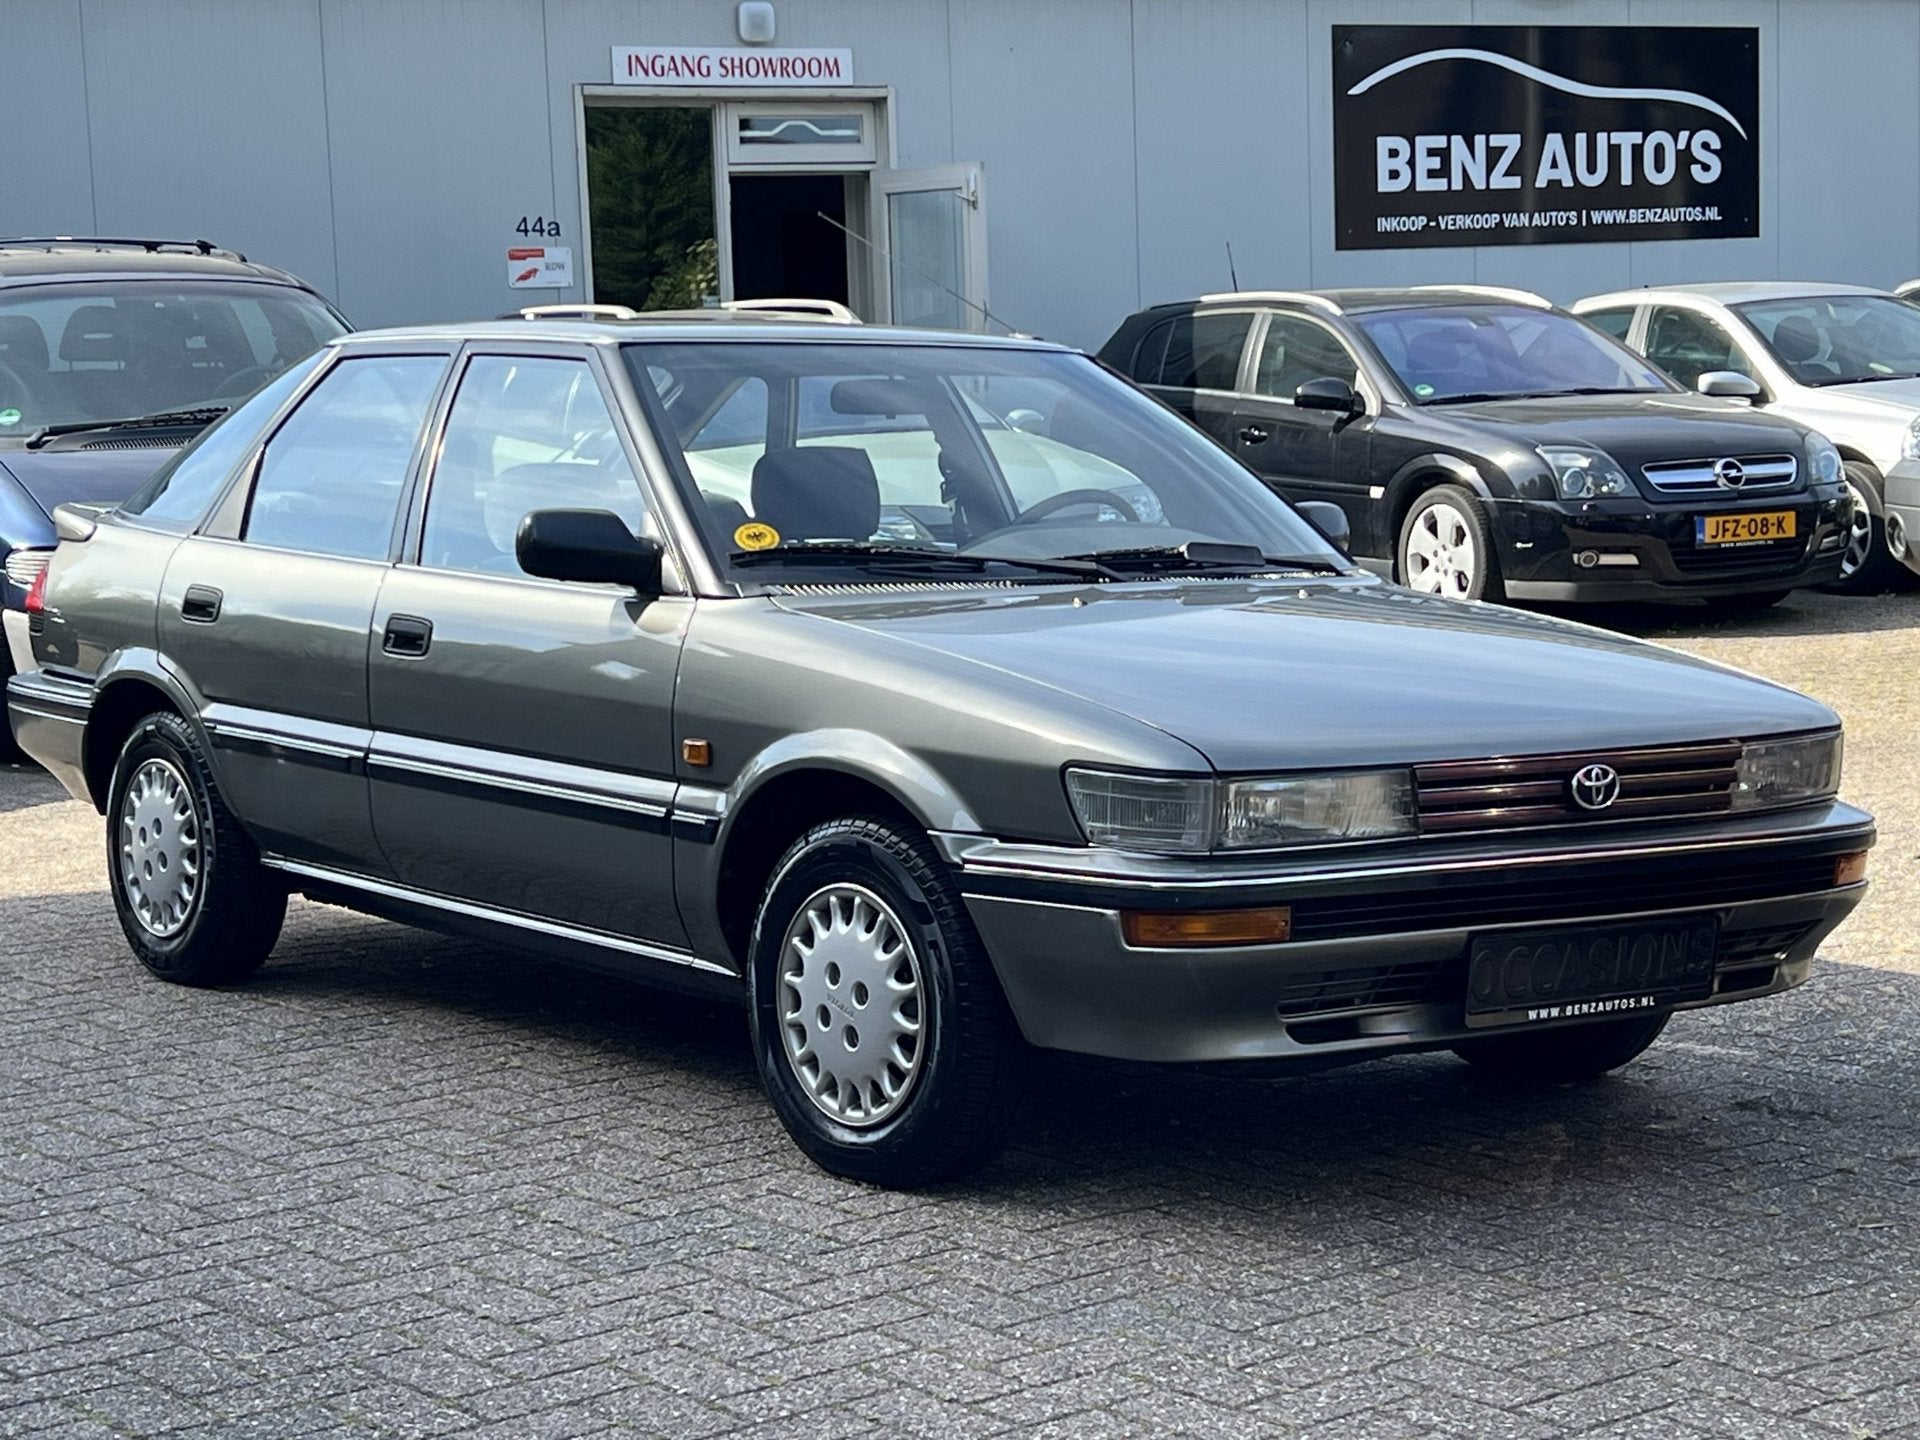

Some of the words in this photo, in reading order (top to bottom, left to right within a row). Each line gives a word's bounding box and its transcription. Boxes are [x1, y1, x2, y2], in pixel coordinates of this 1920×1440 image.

[627, 54, 711, 78] INGANG
[718, 55, 841, 79] SHOWROOM
[1376, 133, 1522, 193] BENZ
[1535, 129, 1722, 188] AUTO'S
[515, 216, 562, 238] 44a
[1376, 216, 1428, 233] INKOOP
[1438, 213, 1501, 230] VERKOOP
[1502, 212, 1530, 228] VAN
[1531, 210, 1578, 227] AUTO'S
[1590, 206, 1723, 225] WWW.BENZAUTOS.NL
[544, 262, 566, 271] RDW
[1711, 515, 1787, 539] JFZ-08-K
[1471, 926, 1713, 1000] OCCASIONS
[1527, 996, 1656, 1021] WWW.BENZAUTOS.NL
